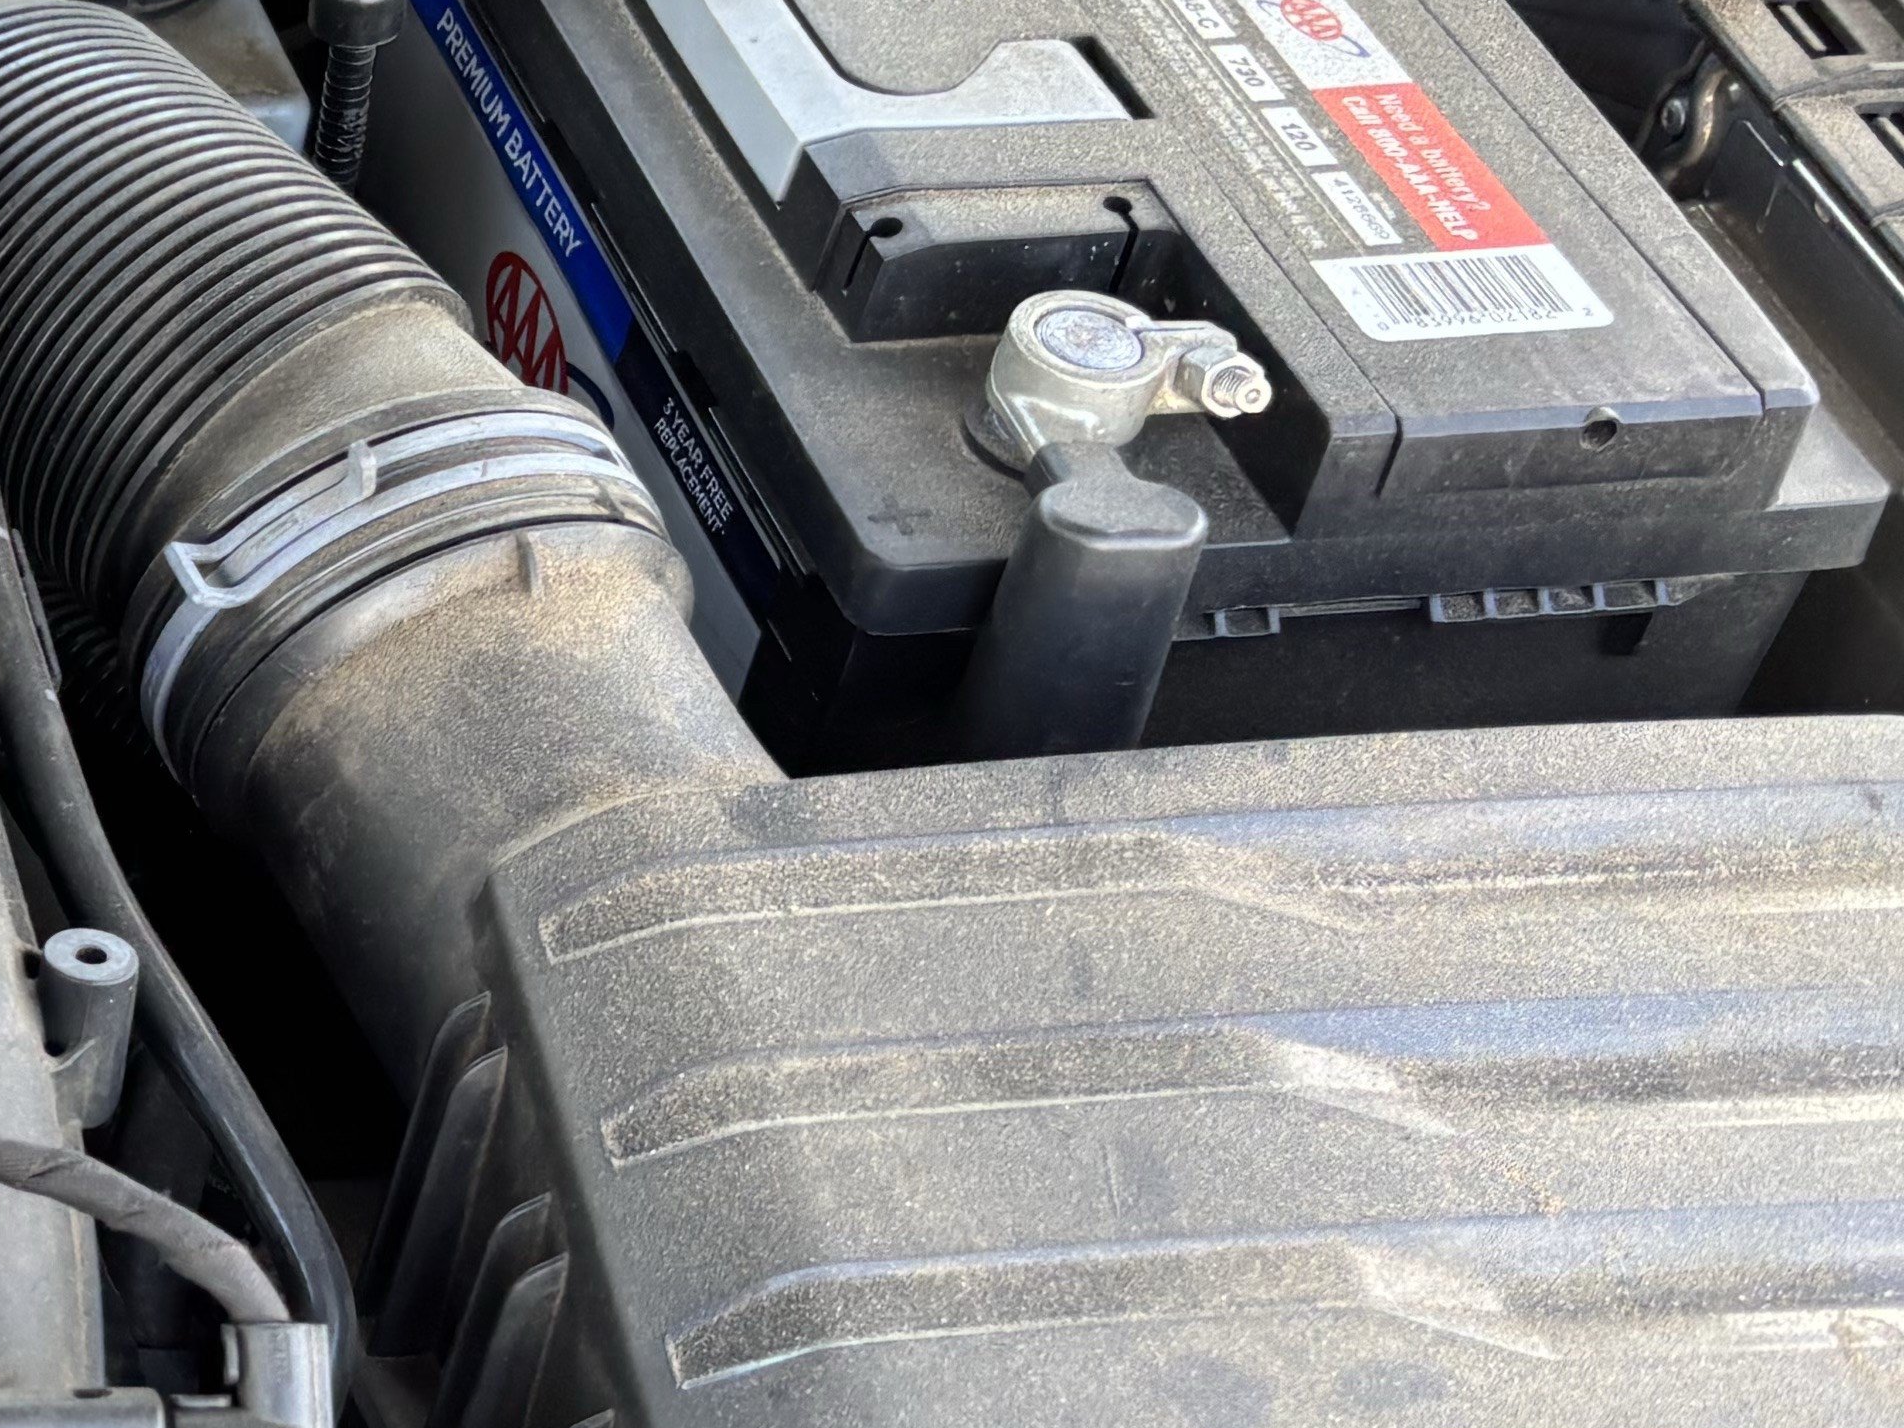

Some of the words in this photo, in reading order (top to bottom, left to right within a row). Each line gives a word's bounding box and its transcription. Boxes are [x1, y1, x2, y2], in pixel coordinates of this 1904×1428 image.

[1227, 58, 1266, 87] 730
[436, 8, 510, 136] PREMIUM
[502, 128, 581, 258] BATTERY
[1281, 124, 1318, 150] 120
[1341, 97, 1377, 127] Call
[1379, 94, 1425, 132] Need
[1421, 149, 1492, 212] battery?
[662, 397, 675, 415] 3
[669, 412, 704, 469] YEAR
[699, 465, 733, 520] FREE
